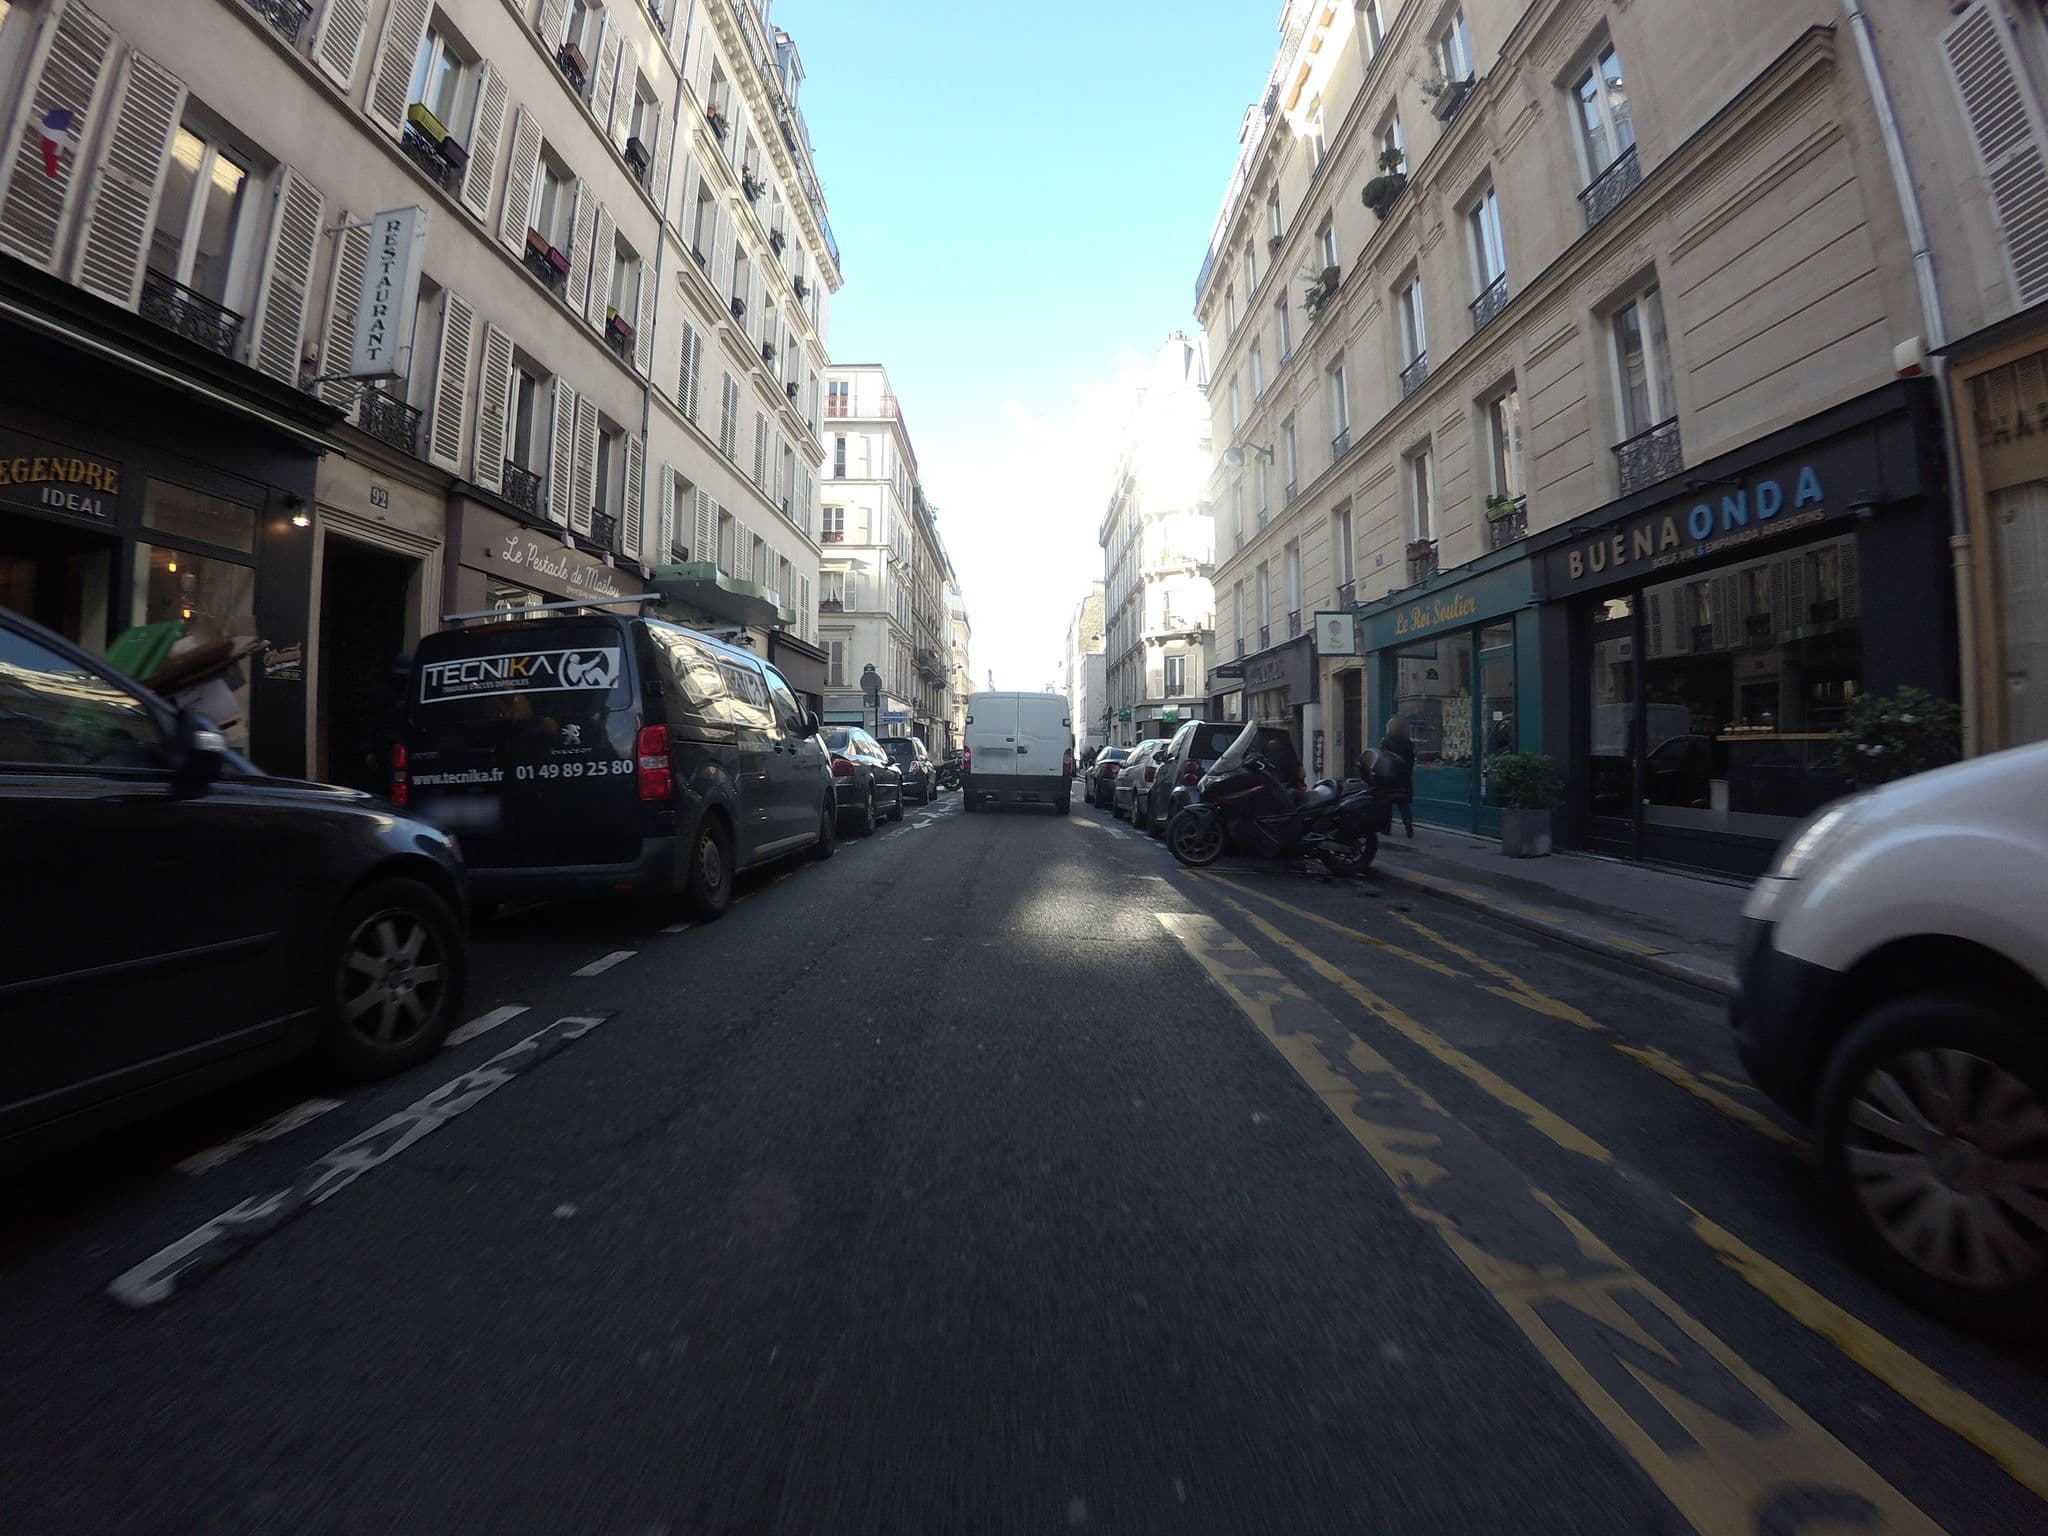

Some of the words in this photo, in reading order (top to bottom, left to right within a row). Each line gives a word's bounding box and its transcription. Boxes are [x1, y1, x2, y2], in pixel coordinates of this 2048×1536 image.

[367, 220, 401, 360] RESTAURANT
[41, 487, 107, 518] IDEAL
[372, 488, 387, 508] 92
[1569, 516, 1681, 580] BUENA
[1688, 465, 1826, 541] ONDA
[503, 536, 523, 564] Le
[526, 542, 569, 581] Pestacle
[570, 563, 583, 586] de
[1395, 614, 1409, 636] Le
[1411, 605, 1431, 632] Roi
[1433, 594, 1478, 625] Soulier
[427, 655, 554, 687] TECNIKA
[412, 767, 504, 786] www.tecnika.fr
[516, 765, 535, 780] 01
[538, 763, 559, 779] 49
[562, 762, 584, 778] 89
[587, 760, 608, 776] 25
[611, 759, 634, 775] 80
